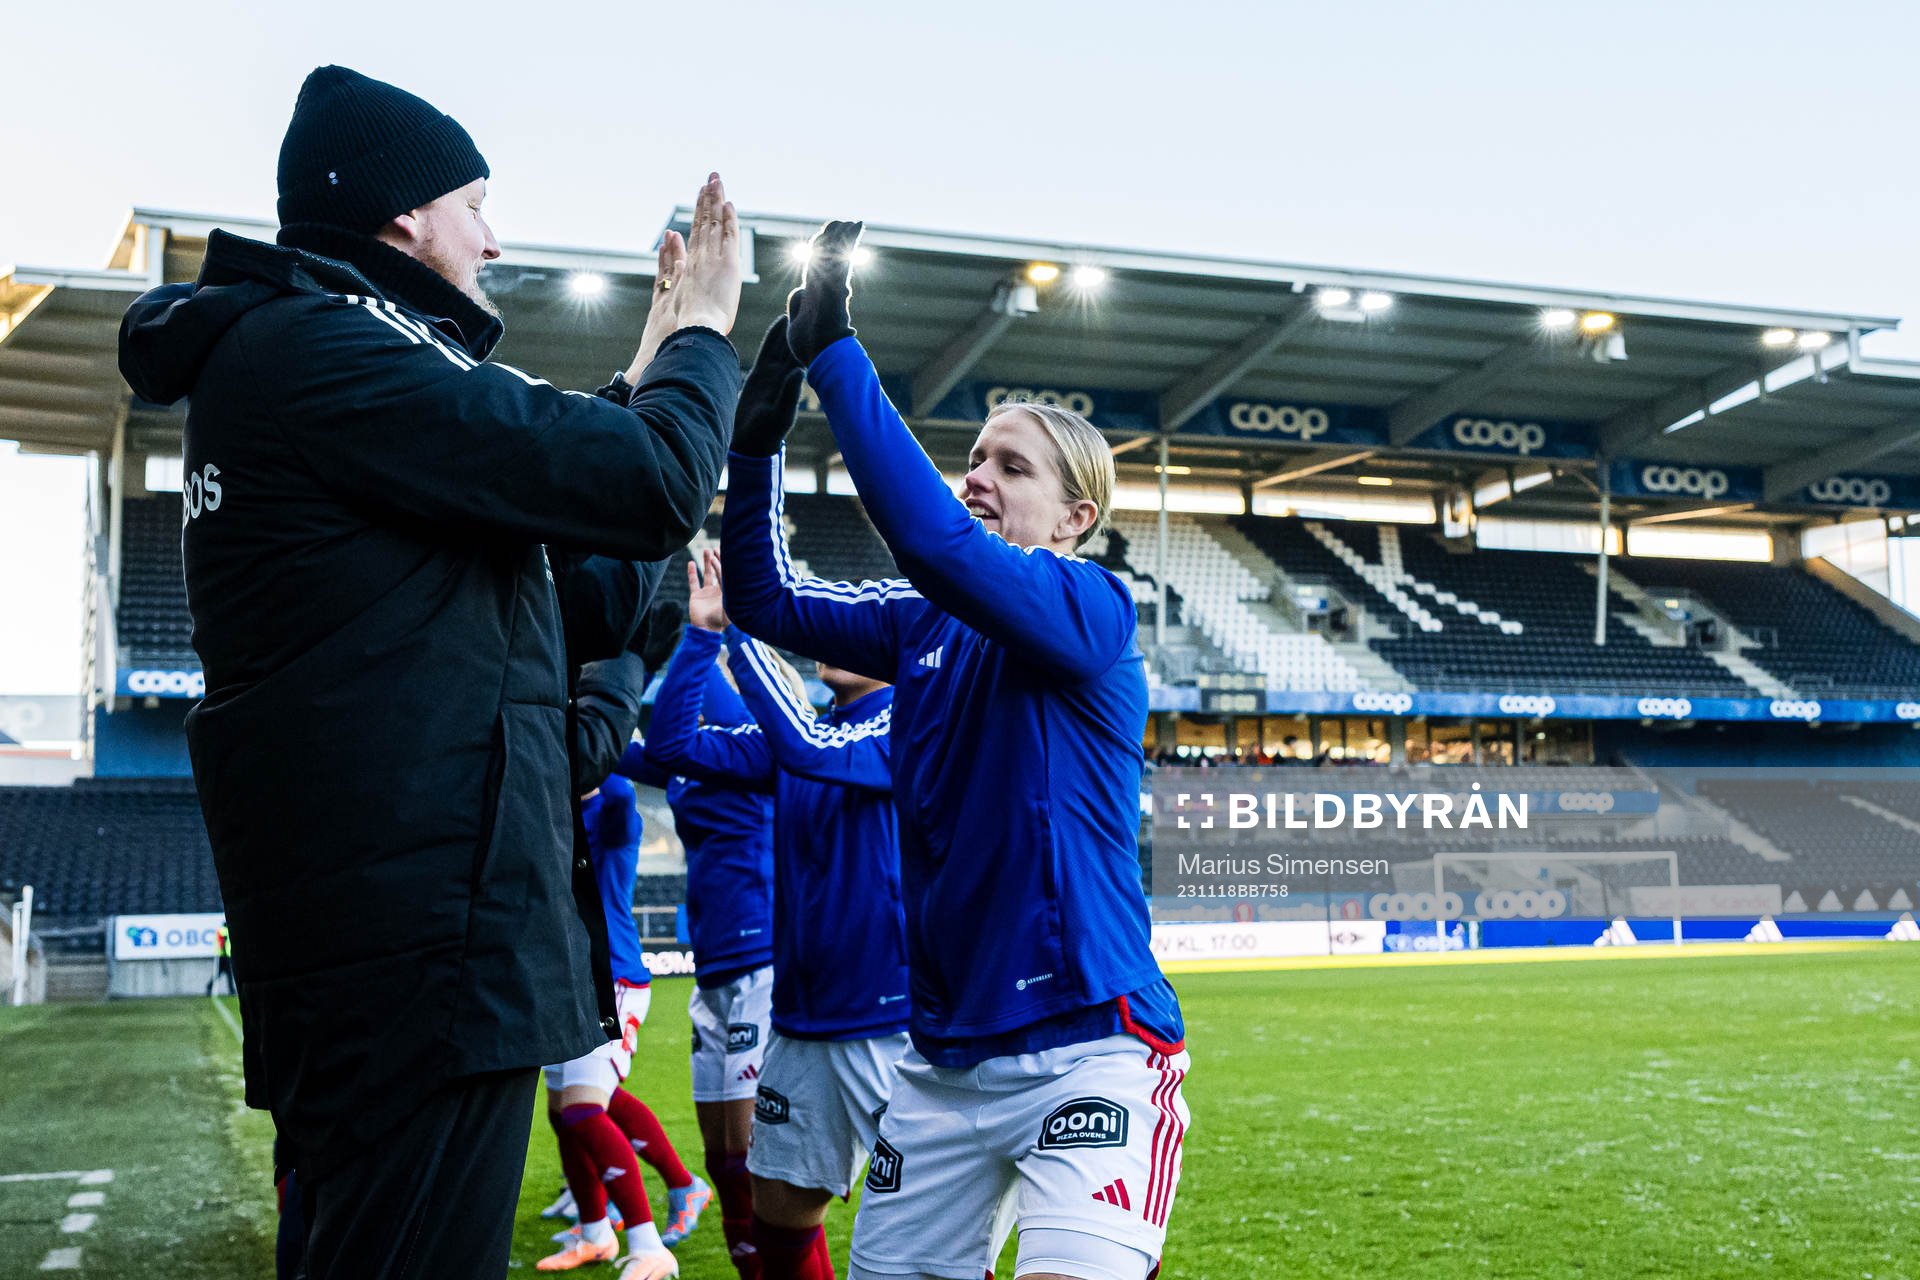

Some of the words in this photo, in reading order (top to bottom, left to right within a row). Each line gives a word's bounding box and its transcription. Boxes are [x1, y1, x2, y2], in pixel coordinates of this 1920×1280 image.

[1229, 402, 1329, 441] coop
[1453, 418, 1546, 456] coop
[1642, 465, 1728, 500] coop
[1809, 477, 1890, 508] coop
[128, 670, 206, 698] coop
[1353, 691, 1412, 714] coop
[1499, 695, 1556, 718] coop
[1638, 697, 1692, 719] coop
[1770, 700, 1821, 721] coop
[1558, 792, 1614, 815] coop
[1049, 1111, 1117, 1135] ooni
[1056, 1132, 1078, 1142] PIZZA
[1079, 1131, 1107, 1139] OVENS
